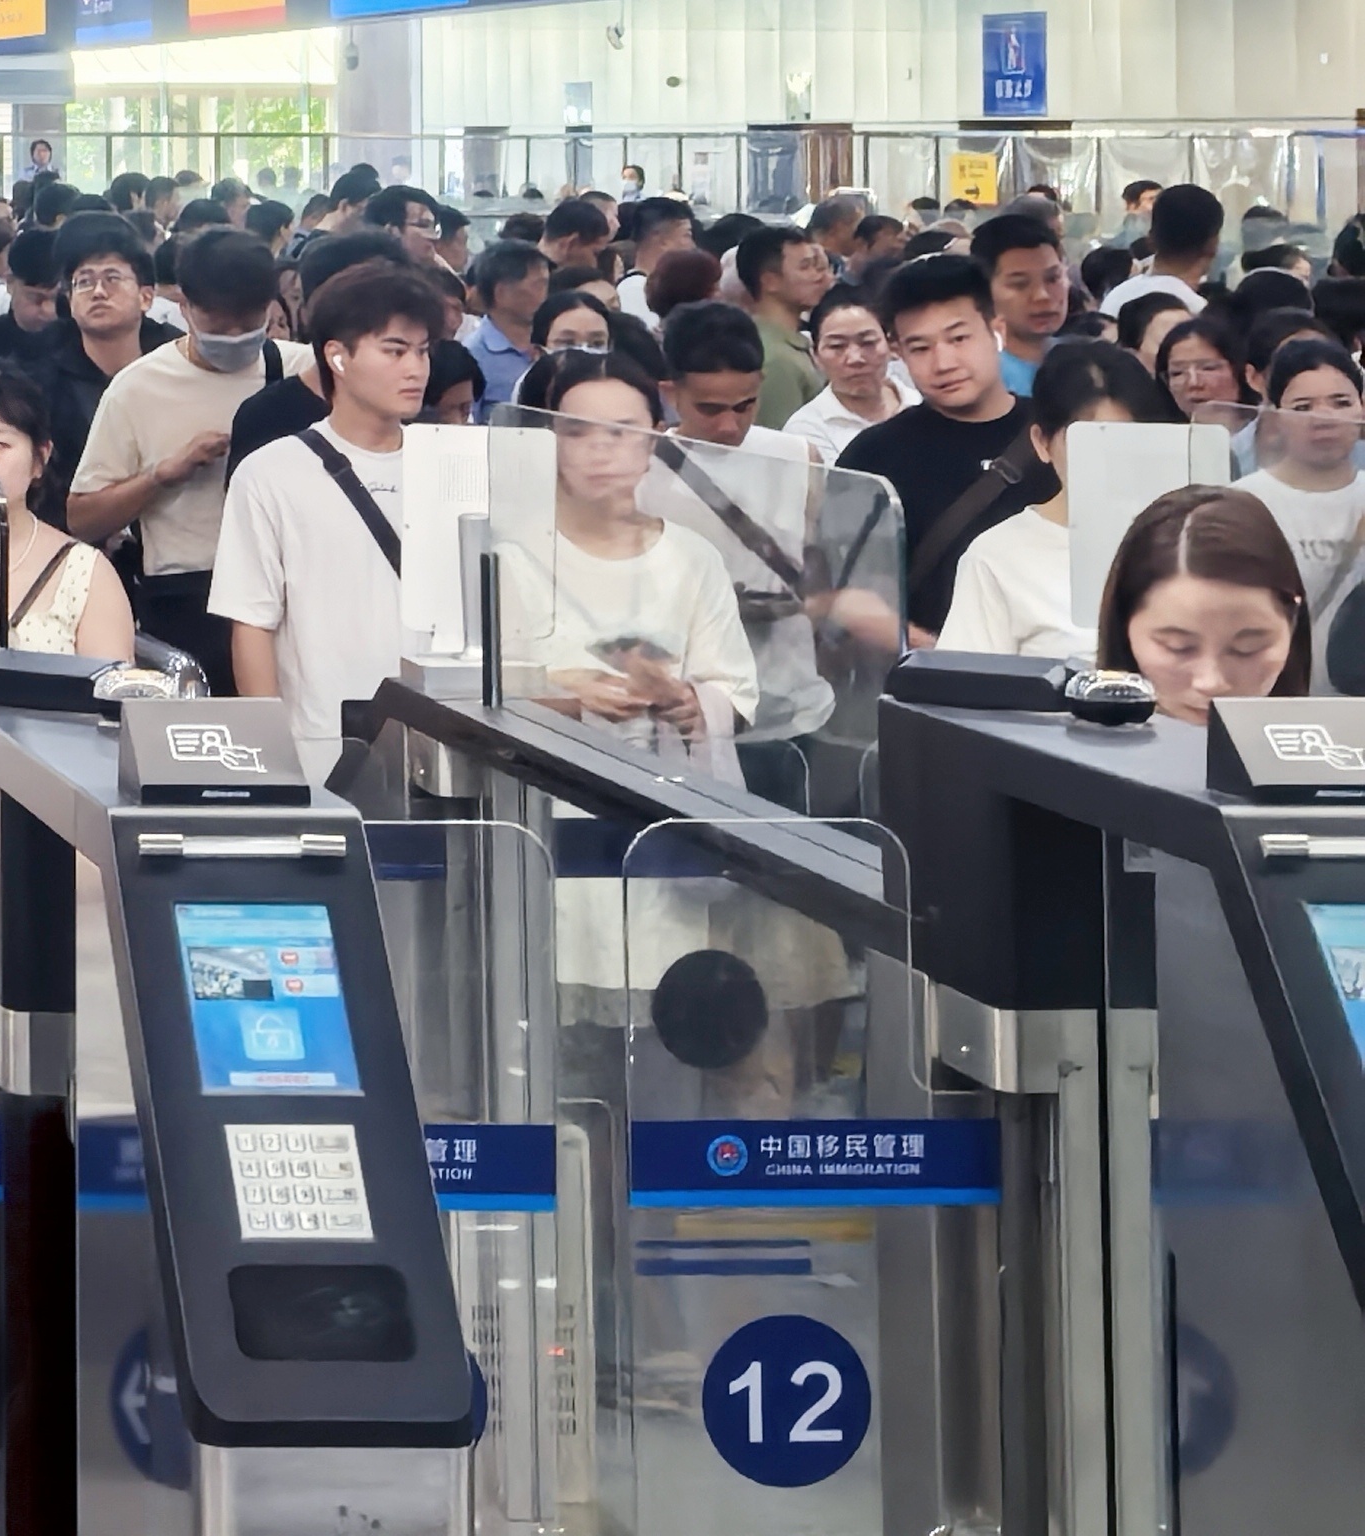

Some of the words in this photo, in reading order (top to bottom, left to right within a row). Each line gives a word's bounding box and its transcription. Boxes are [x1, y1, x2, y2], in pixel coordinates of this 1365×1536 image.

[760, 1133, 926, 1159] 中国移民管理
[765, 1163, 814, 1176] CHINA
[819, 1163, 921, 1176] IMMIGRATION
[727, 1360, 844, 1444] 12
